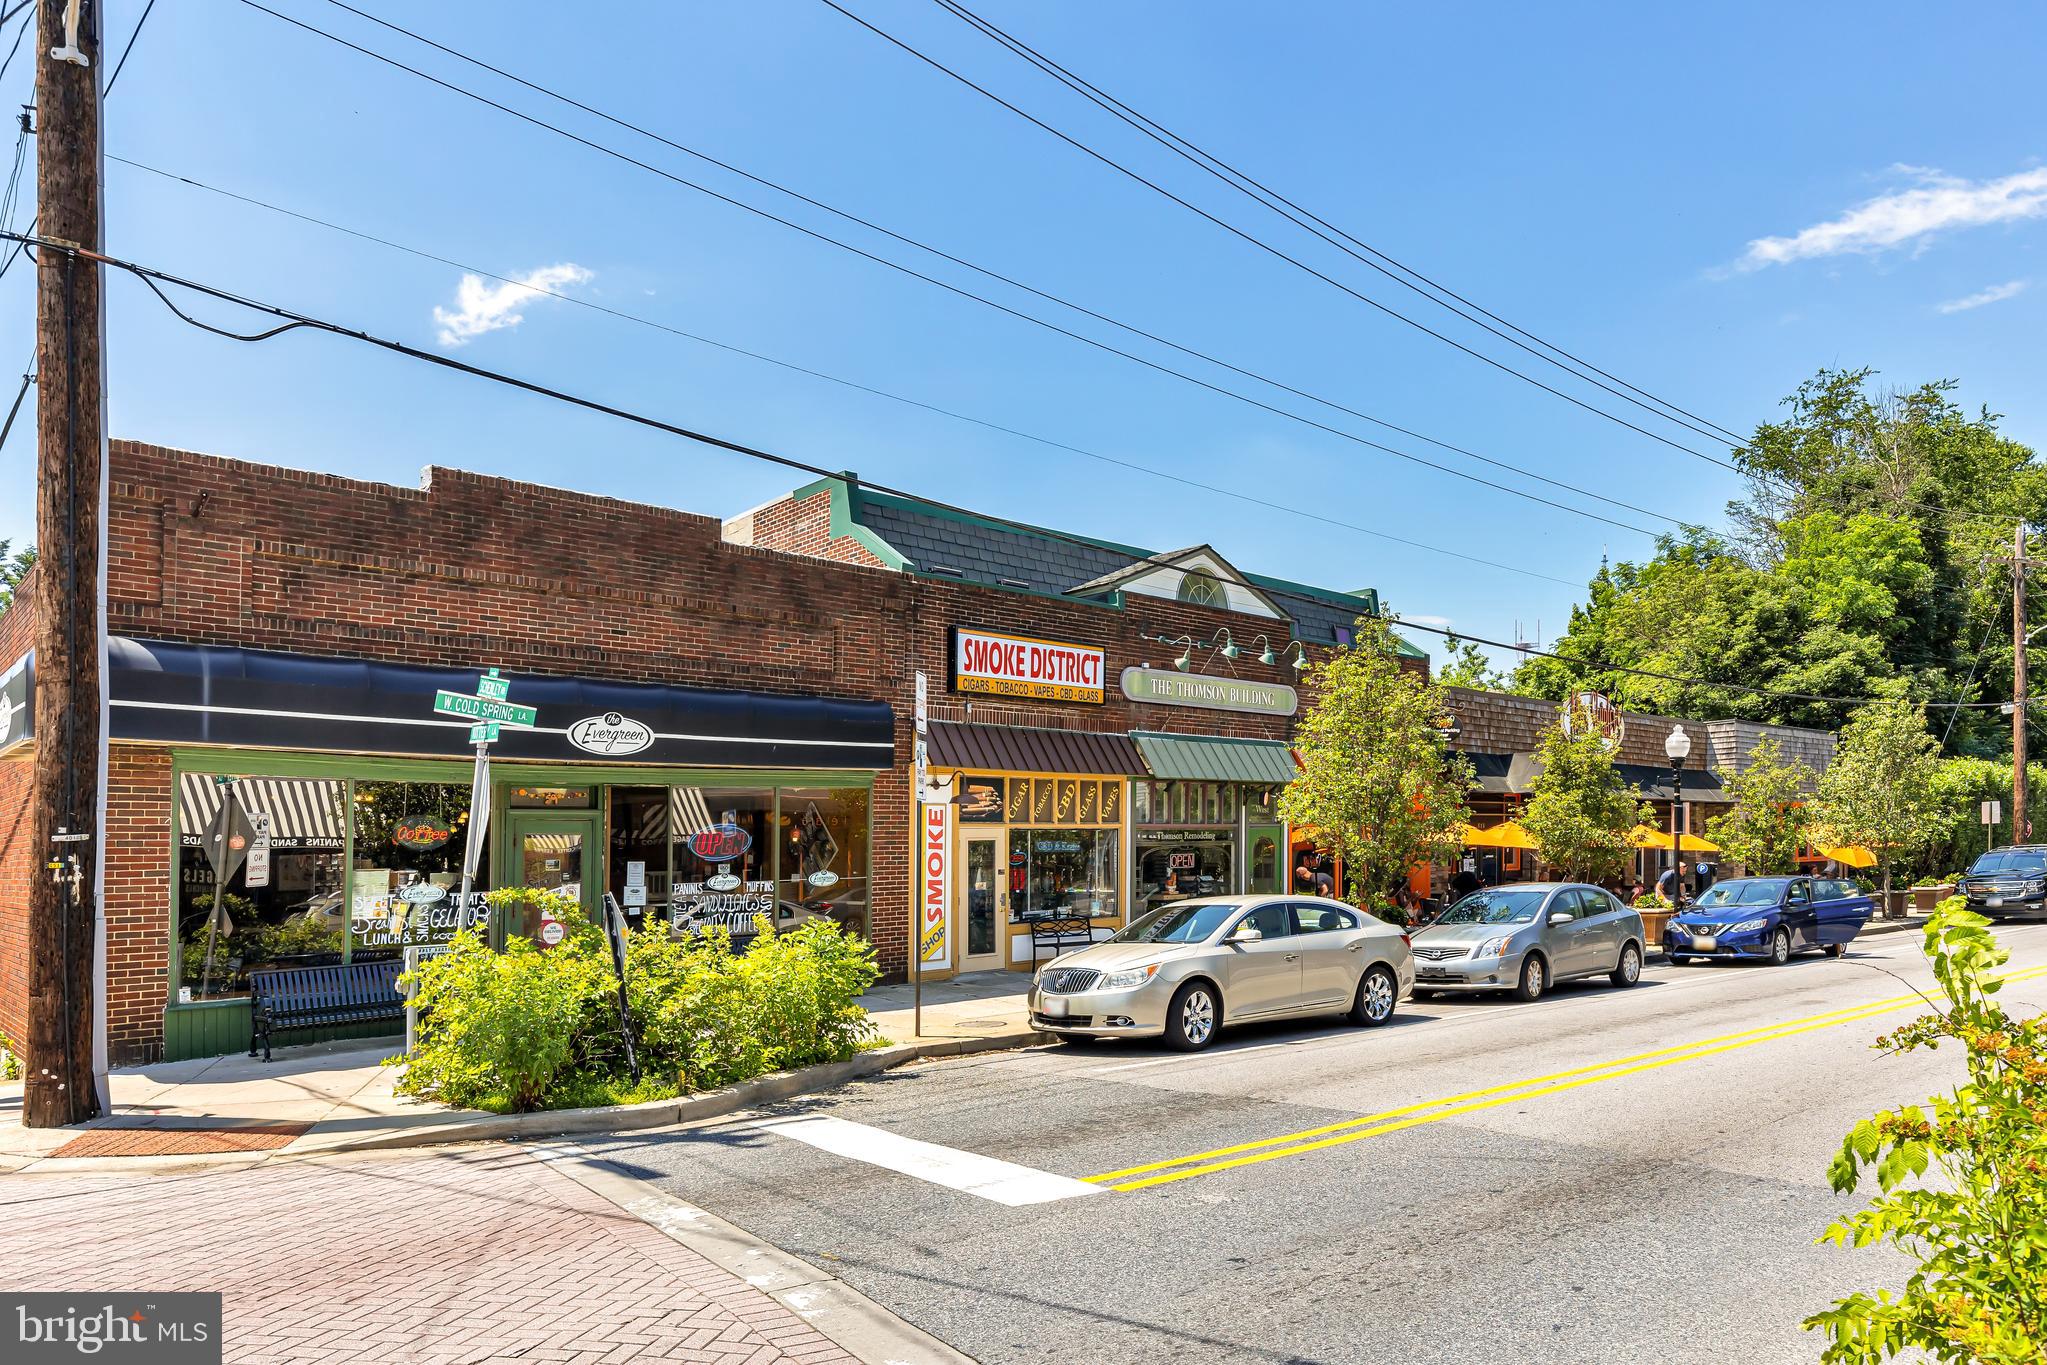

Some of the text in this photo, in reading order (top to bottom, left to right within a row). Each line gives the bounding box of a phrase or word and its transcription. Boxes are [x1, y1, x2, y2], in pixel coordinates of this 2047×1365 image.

[964, 638, 1100, 685] SMOKE DISTRICT
[962, 678, 1099, 702] CIGARS TOBACCO VAPES CBD GLASS
[1150, 678, 1275, 706] THE THOMSON BUILDING
[443, 695, 528, 720] W. COLD SPRING LA.
[606, 715, 620, 725] the
[582, 722, 644, 752] Evergreen
[1009, 782, 1029, 819] CIGAR
[1034, 783, 1053, 818] TOBACCO
[1057, 783, 1075, 819] CBD
[1080, 785, 1097, 819] GLASS
[1102, 786, 1119, 818] VAPES
[397, 826, 449, 840] Coffee
[696, 831, 745, 855] OPEN
[1157, 831, 1183, 840] Thomson
[1184, 831, 1216, 841] Remodeling
[927, 808, 944, 922] SMOKE
[1171, 855, 1194, 867] OPEN
[449, 893, 487, 906] TRATS
[746, 881, 774, 892] MUFFINS
[416, 904, 429, 942] SNACKS
[430, 908, 477, 928] GELAO
[364, 932, 400, 945] LUNCH
[921, 926, 945, 954] SHOP
